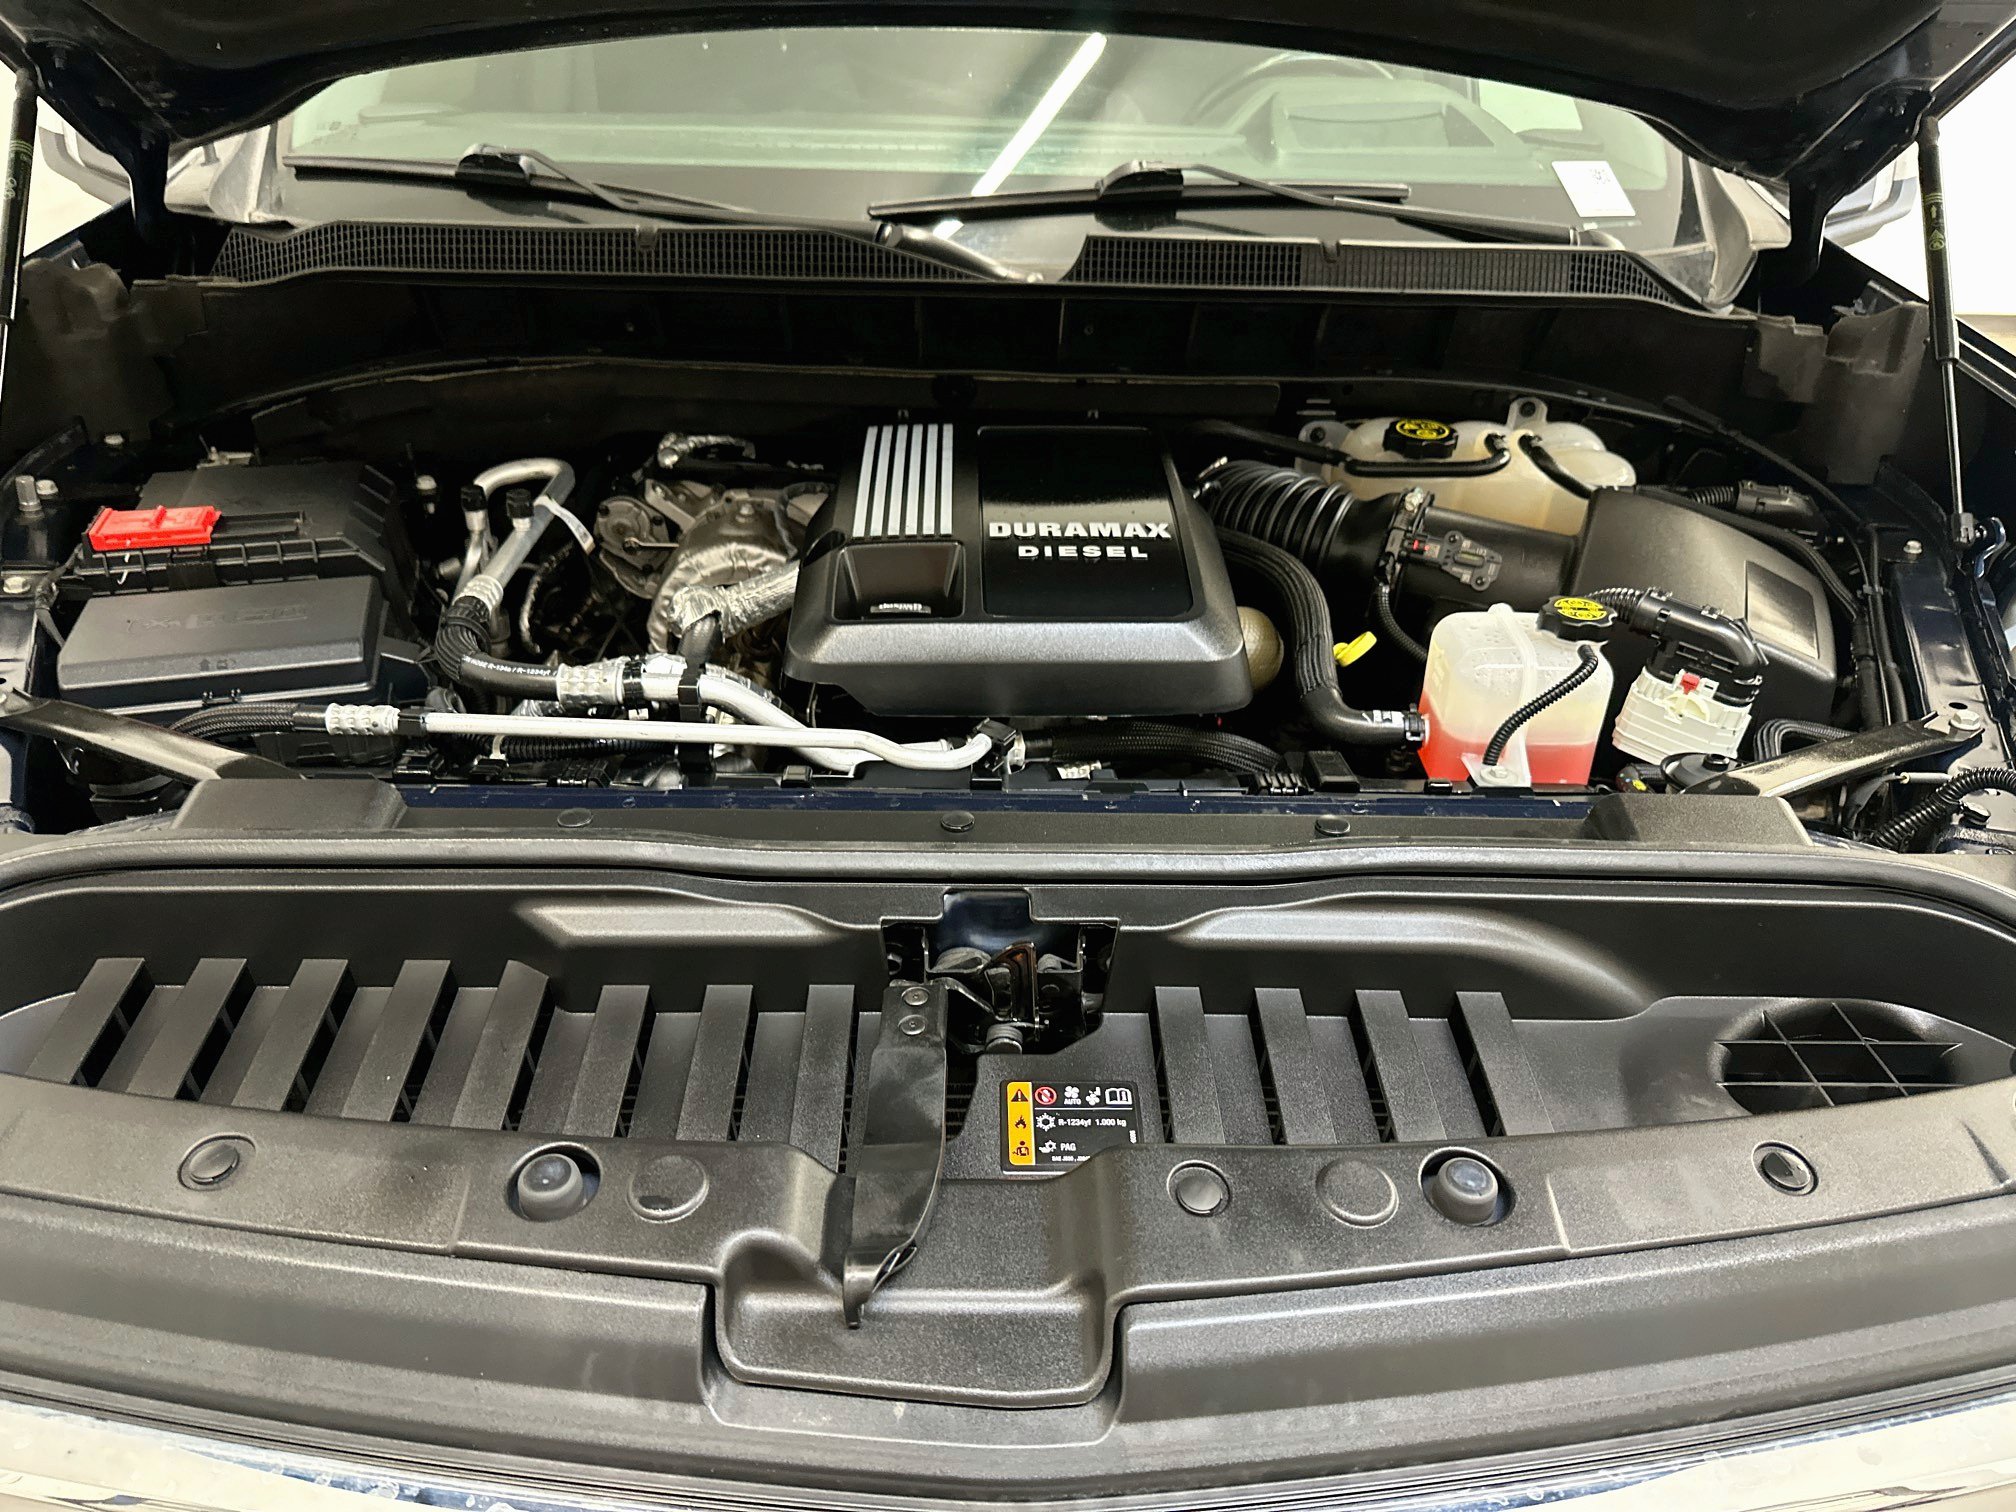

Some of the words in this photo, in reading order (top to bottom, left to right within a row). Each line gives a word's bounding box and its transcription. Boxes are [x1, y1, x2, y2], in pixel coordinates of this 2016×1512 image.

[988, 522, 1171, 538] DURAMAX
[1018, 545, 1148, 558] DIESEL
[517, 668, 550, 677] R-1234yf
[1058, 1119, 1092, 1127] R-1234yf
[1117, 1119, 1127, 1127] kg
[1060, 1143, 1077, 1151] PAG
